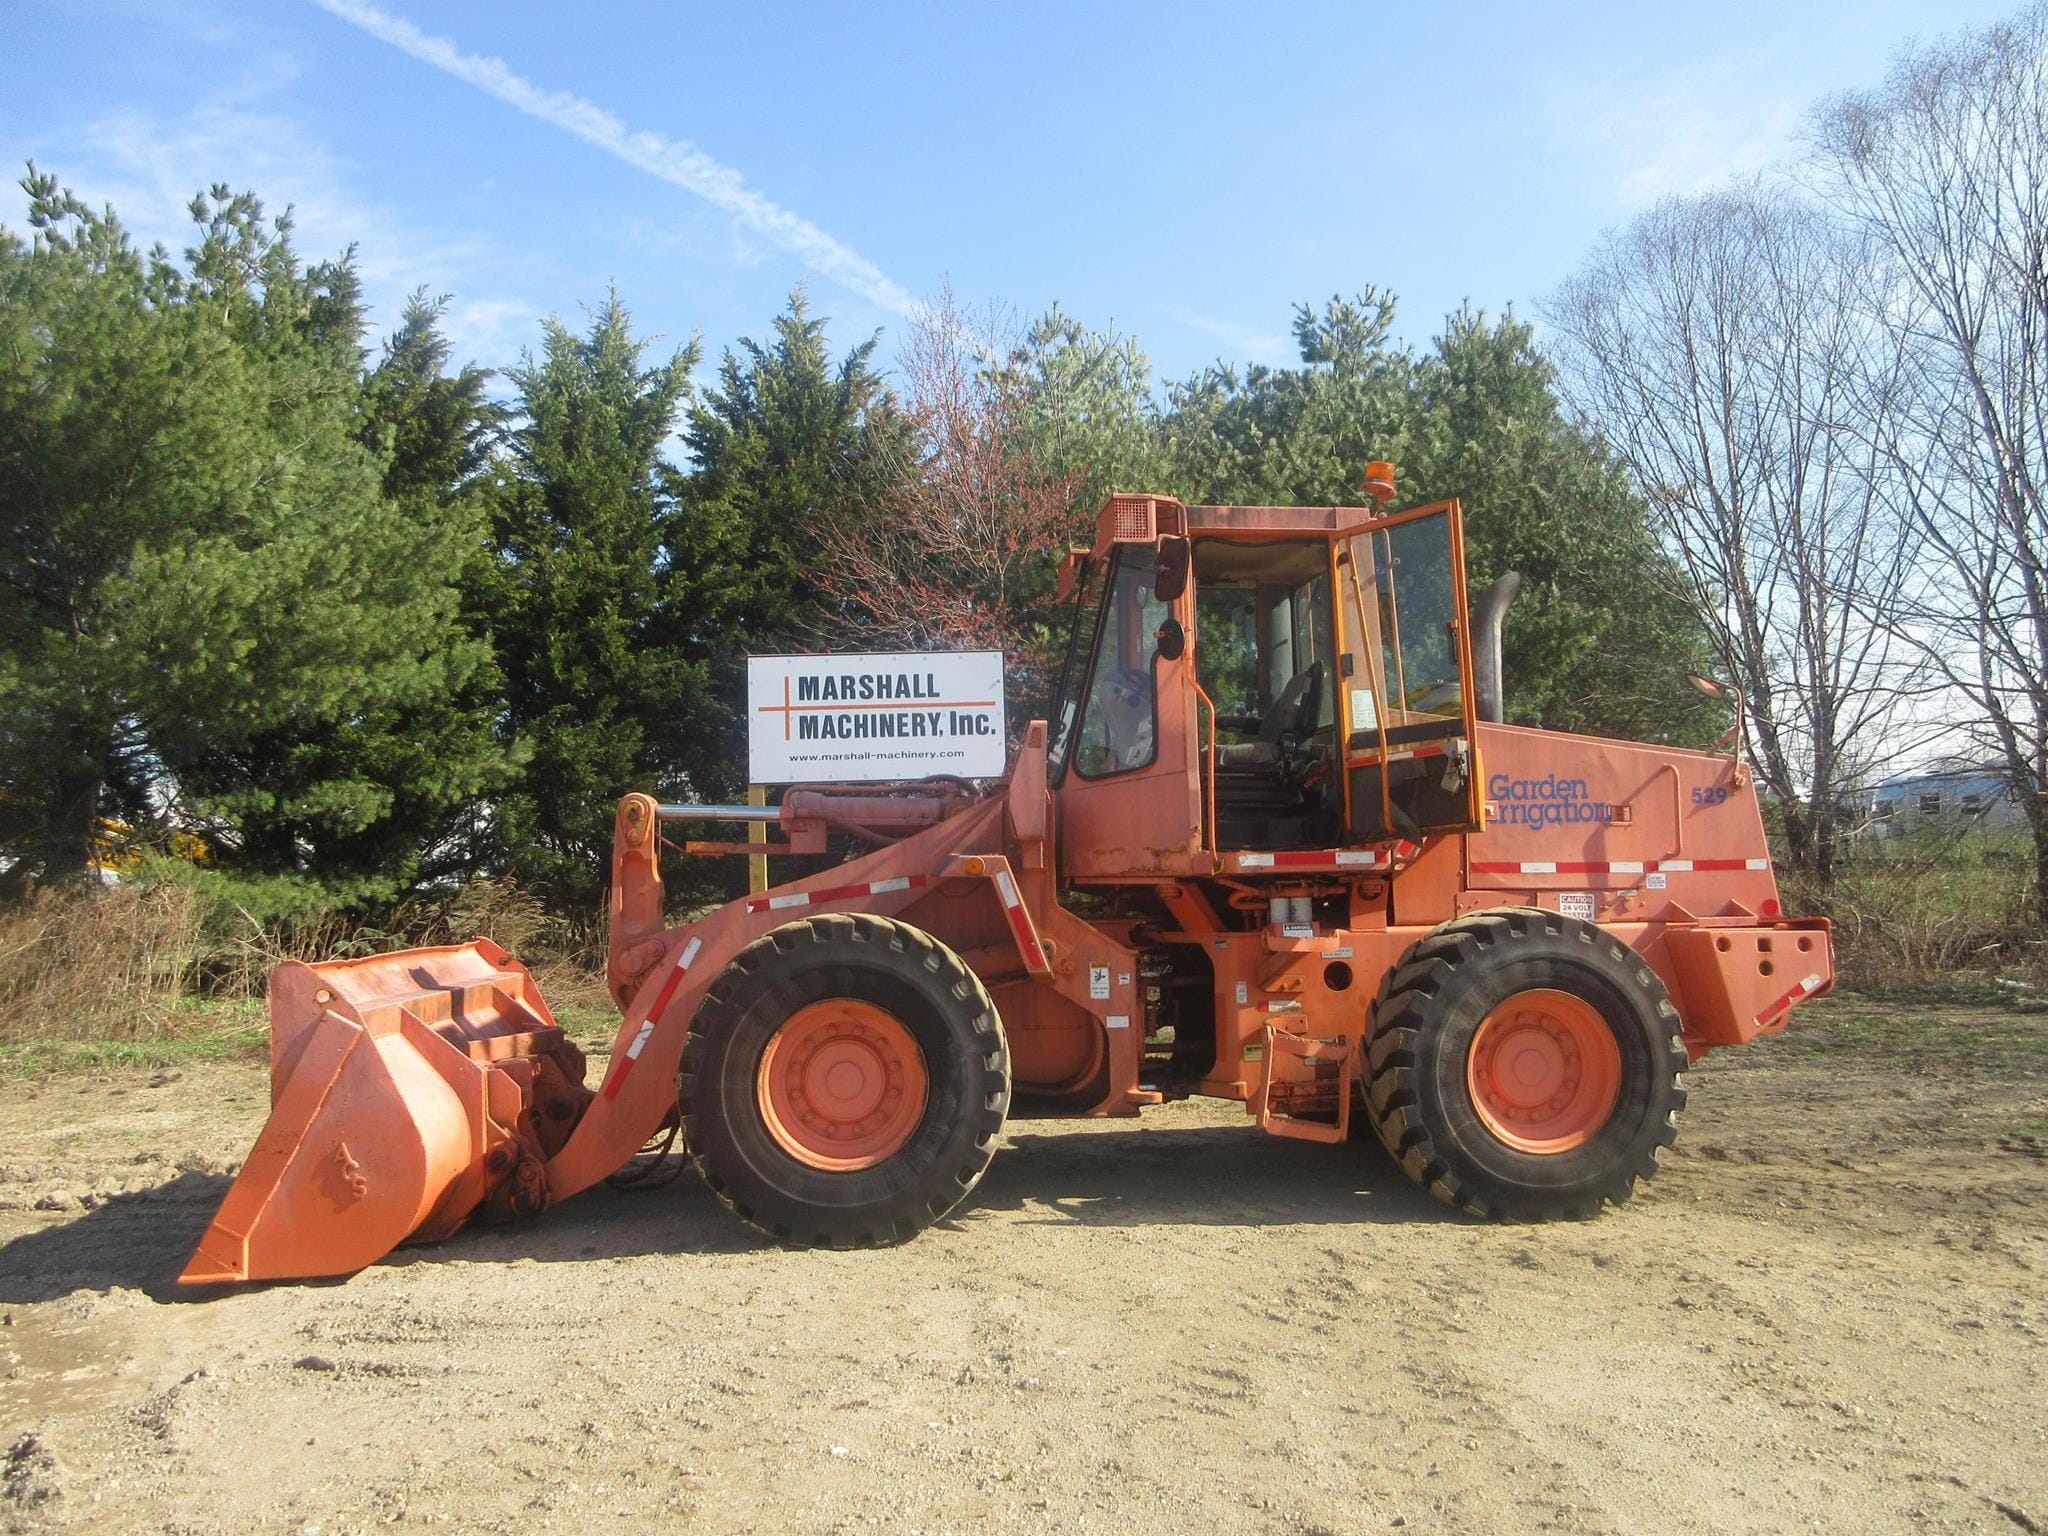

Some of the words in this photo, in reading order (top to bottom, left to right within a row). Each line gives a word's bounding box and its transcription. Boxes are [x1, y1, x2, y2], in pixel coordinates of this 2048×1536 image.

[798, 673, 940, 701] MARSHALL
[799, 712, 944, 740] MACHINERY,
[950, 710, 996, 736] Inc.
[789, 750, 965, 762] www.marshall-machinery.com
[1489, 773, 1588, 801] Garden
[1691, 787, 1728, 804] 529
[1490, 798, 1612, 831] rrigation
[1562, 896, 1593, 904] CAUTION
